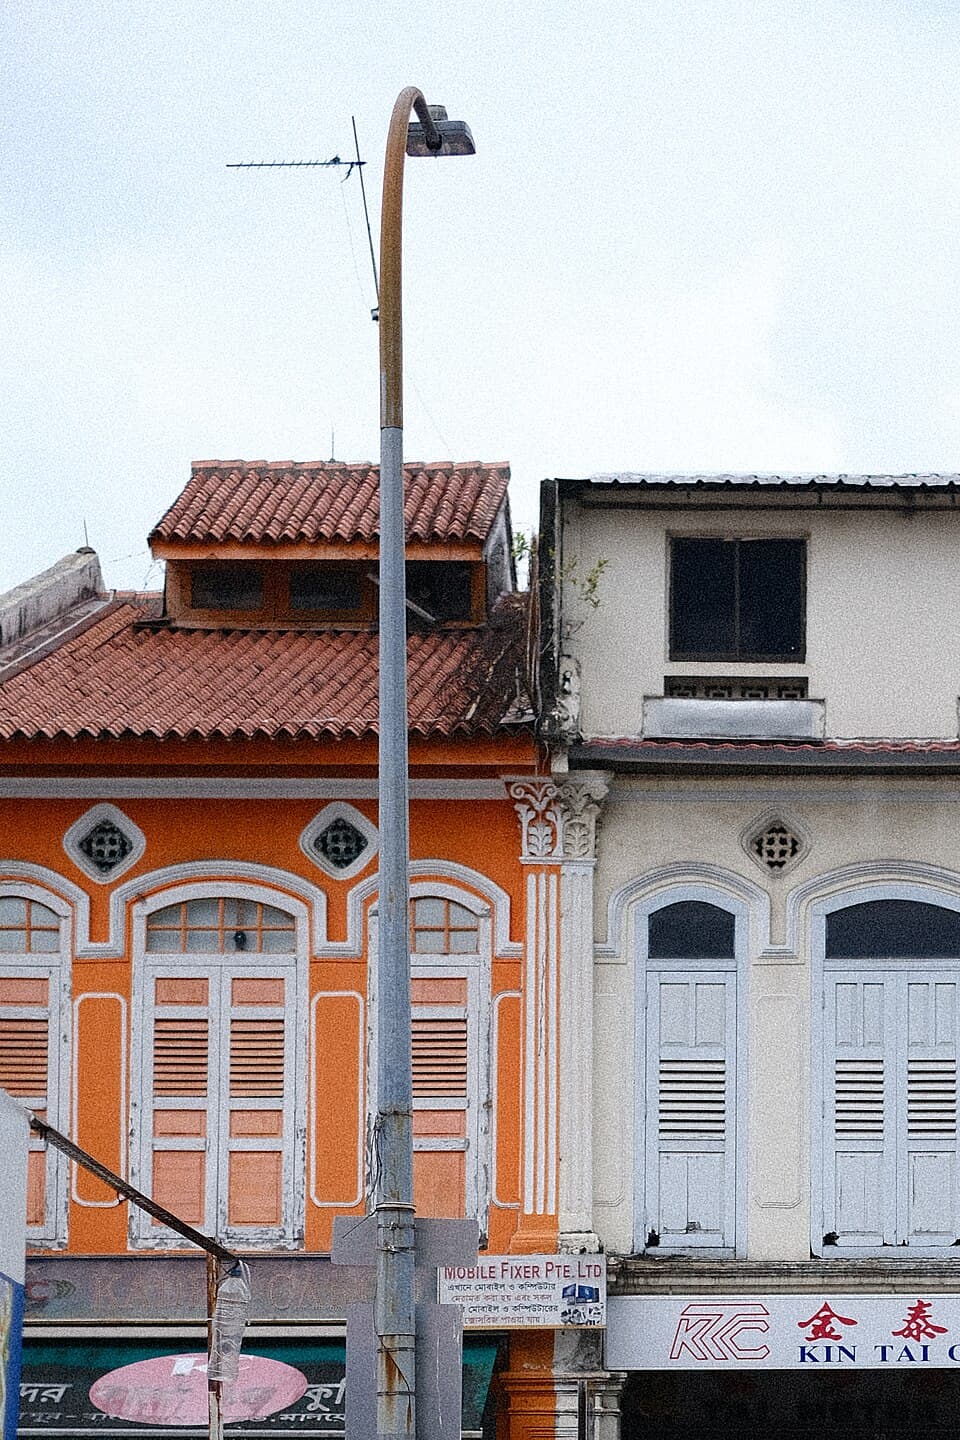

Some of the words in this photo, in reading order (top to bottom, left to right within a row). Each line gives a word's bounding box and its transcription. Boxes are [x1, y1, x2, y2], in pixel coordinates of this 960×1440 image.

[444, 1265, 496, 1280] MOBILE
[501, 1262, 540, 1279] FIXER
[545, 1261, 575, 1279] PTE.
[578, 1261, 602, 1278] LTD
[799, 1345, 857, 1363] KIN
[874, 1344, 930, 1362] TAI
